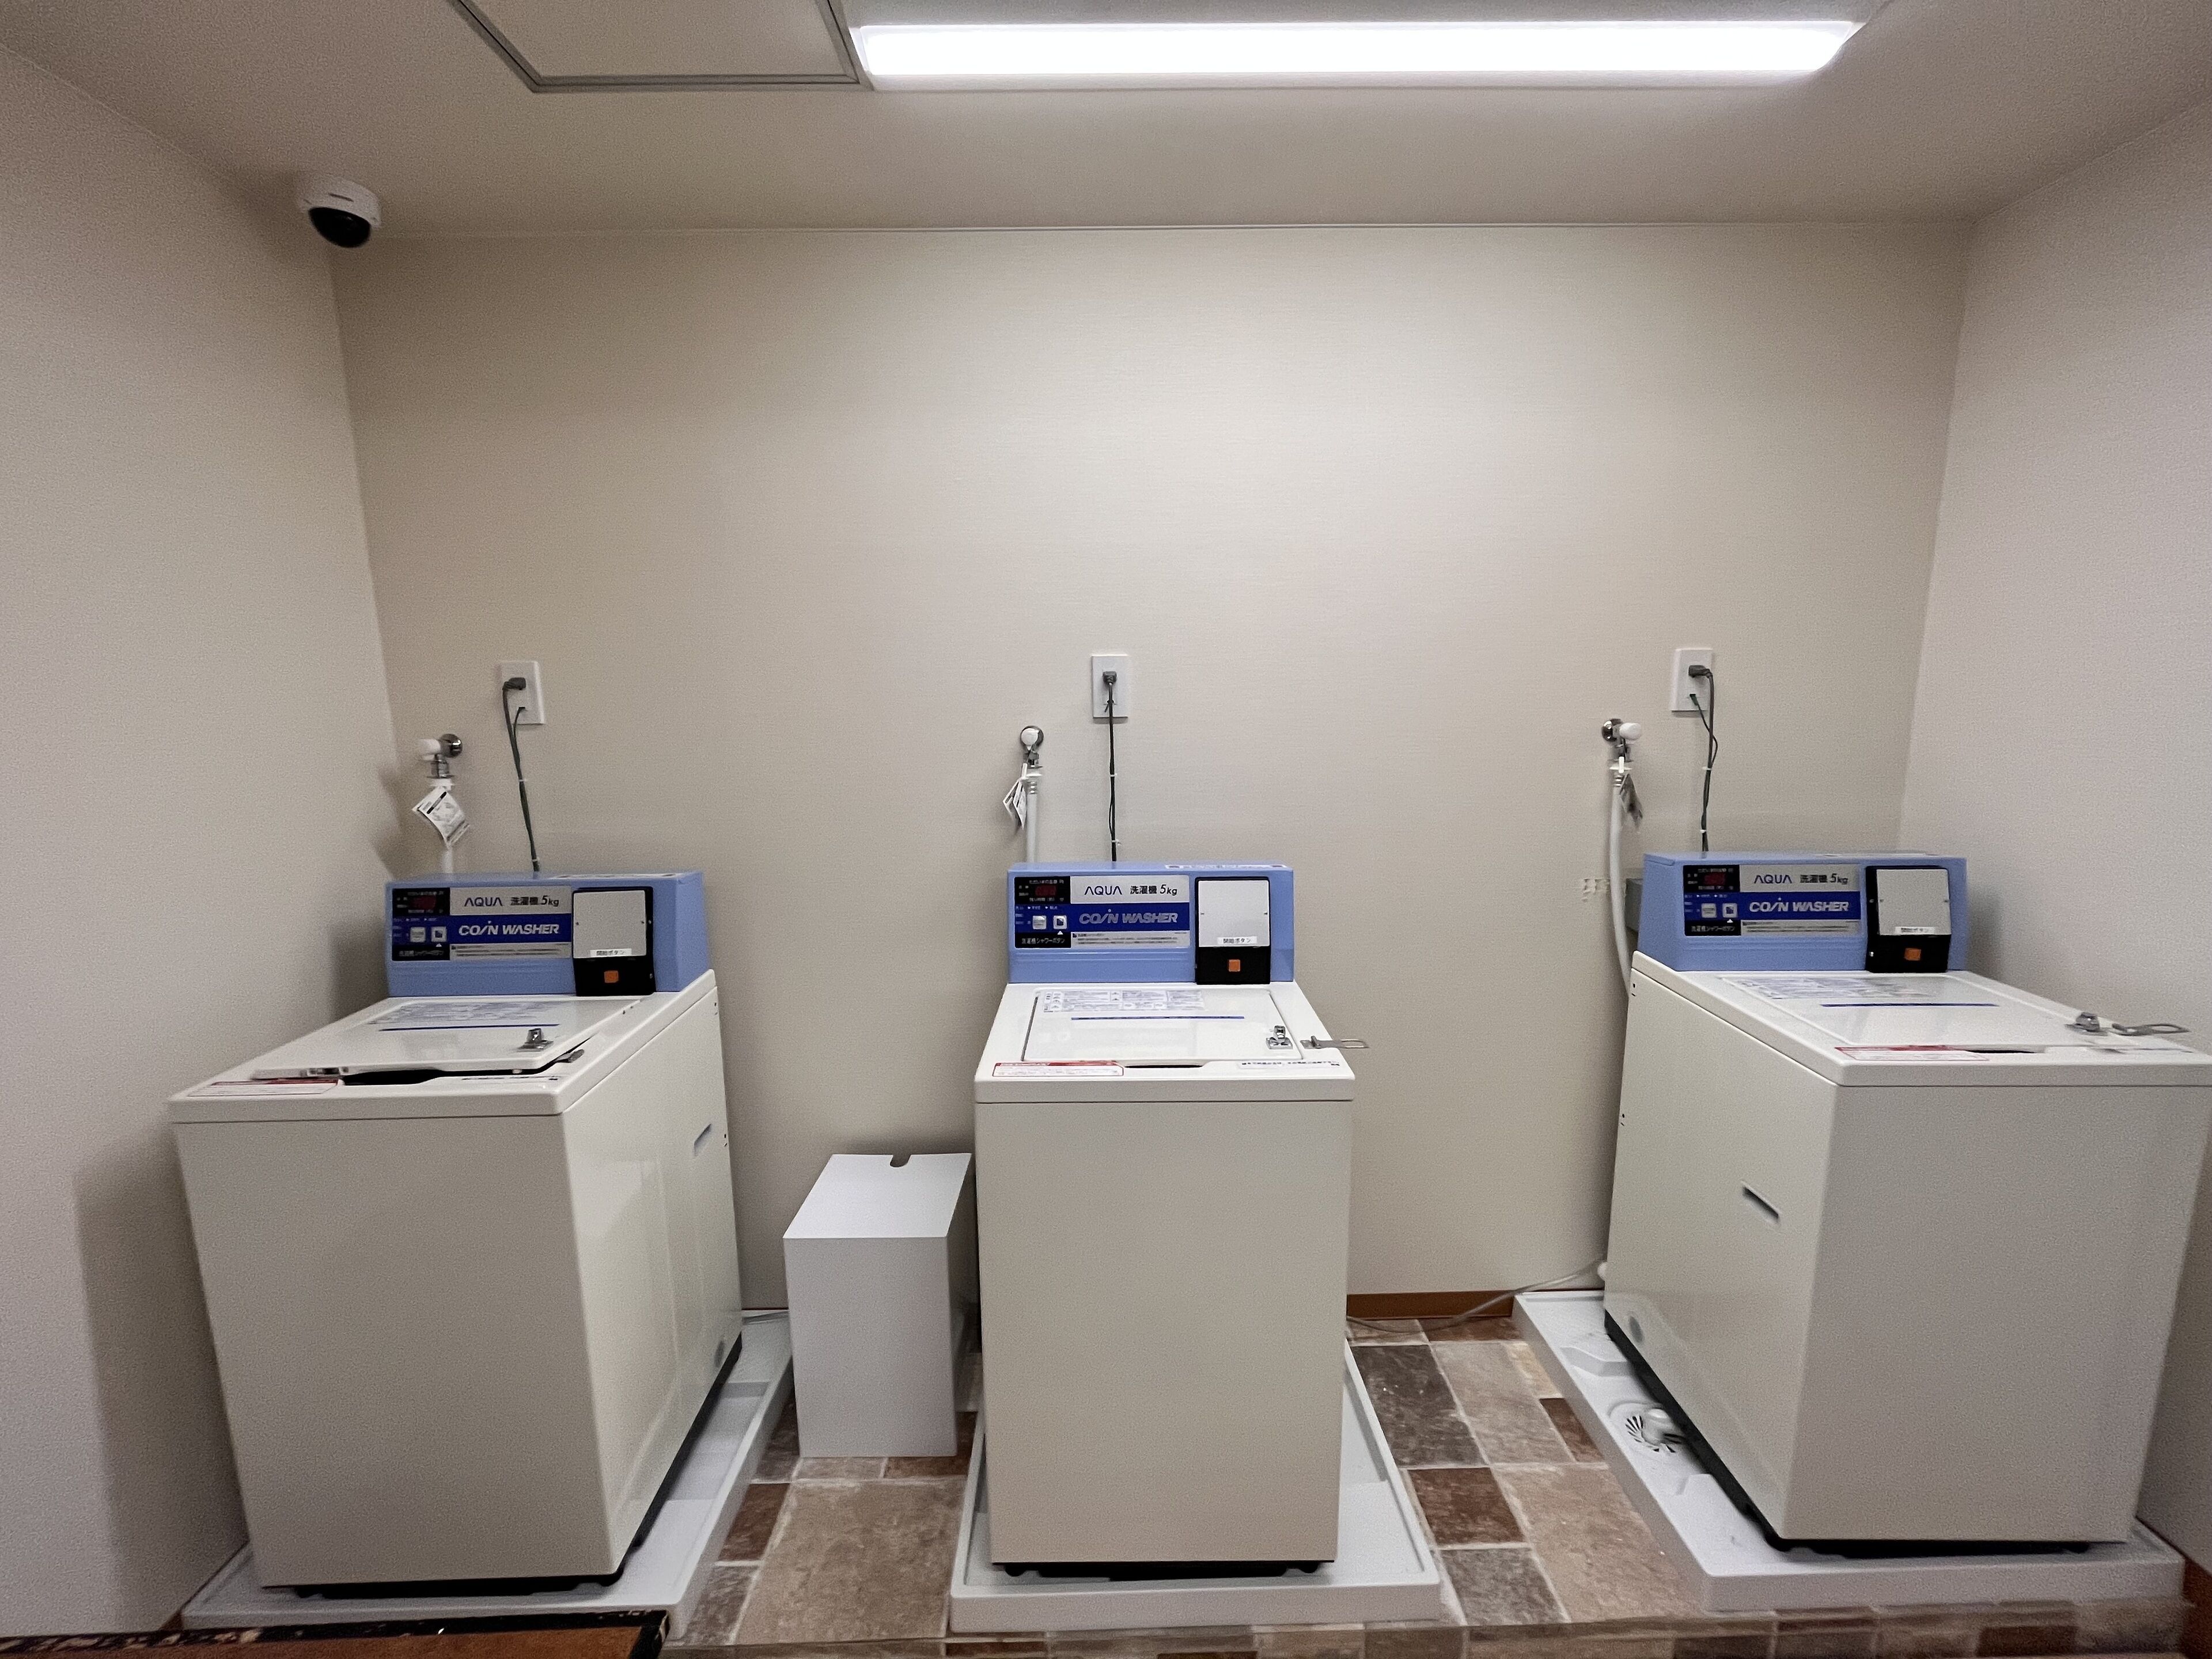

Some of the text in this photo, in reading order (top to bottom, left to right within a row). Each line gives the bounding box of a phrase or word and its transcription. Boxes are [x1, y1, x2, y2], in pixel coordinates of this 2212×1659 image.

[1754, 874, 1793, 884] AQUA
[1830, 873, 1849, 885] 5kg
[1084, 884, 1177, 896] AQUA 洗濯機 5kg
[464, 897, 503, 907] AQUA
[540, 895, 559, 907] 5kg
[1749, 897, 1850, 912] COIN WASHER
[1079, 909, 1178, 924] COIN WASHER
[459, 921, 560, 936] COIN WASHER
